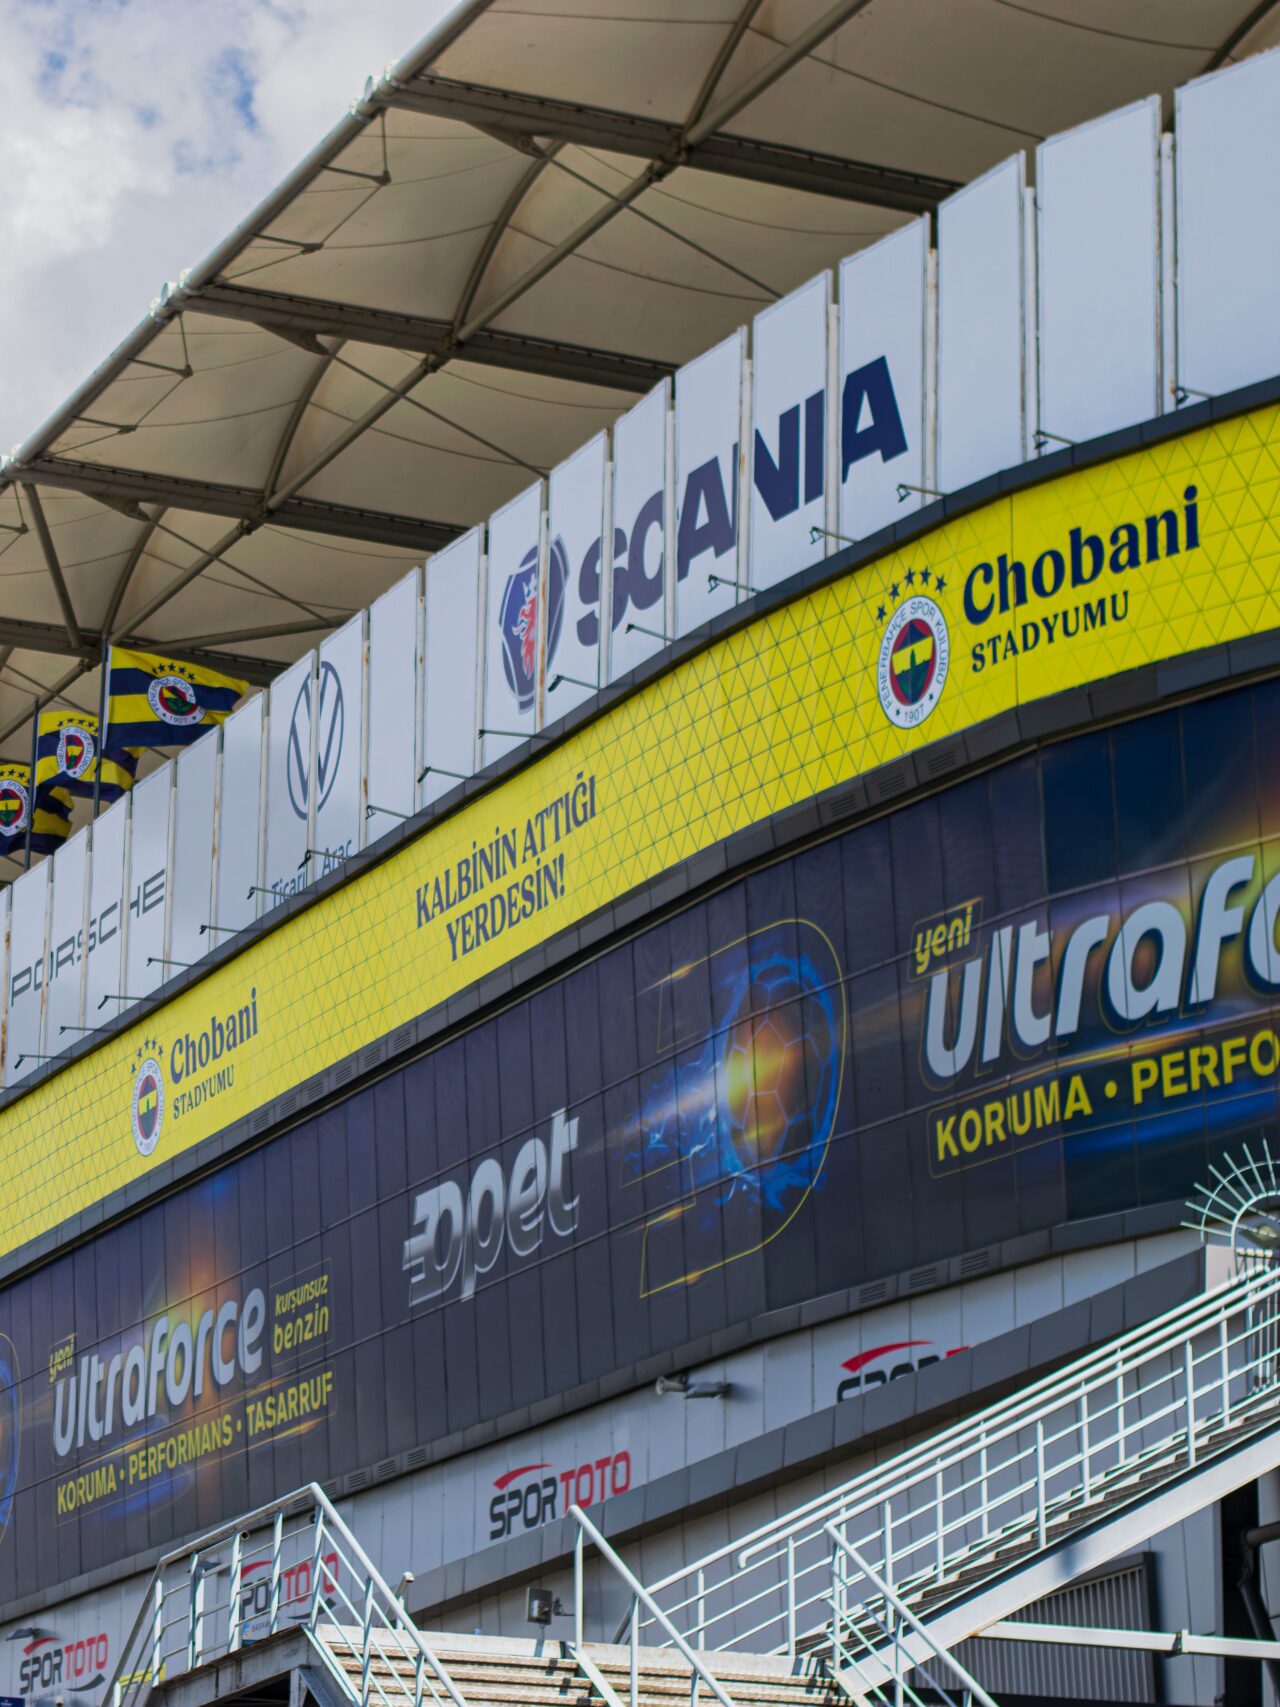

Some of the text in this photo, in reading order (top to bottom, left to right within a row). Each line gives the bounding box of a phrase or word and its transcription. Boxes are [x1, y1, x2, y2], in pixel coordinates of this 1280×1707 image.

[577, 355, 909, 647] SCANIA
[963, 484, 1200, 625] Chobani
[910, 601, 936, 619] SPOR
[971, 590, 1129, 673] STADYUMU
[903, 703, 924, 723] 1907
[415, 771, 596, 929] KALBİNİN ATTIĞI
[11, 868, 166, 1008] PORSCHE
[446, 853, 565, 962] YERDESİN!
[915, 905, 973, 974] yeni
[170, 987, 258, 1085] Chobani
[173, 1064, 234, 1120] STADYUMU
[936, 1075, 1093, 1161] KORUMA
[49, 1337, 75, 1383] yeni
[273, 1306, 329, 1354] benzin
[57, 1371, 334, 1515] KORUMA PERFORMANS TASARRUF
